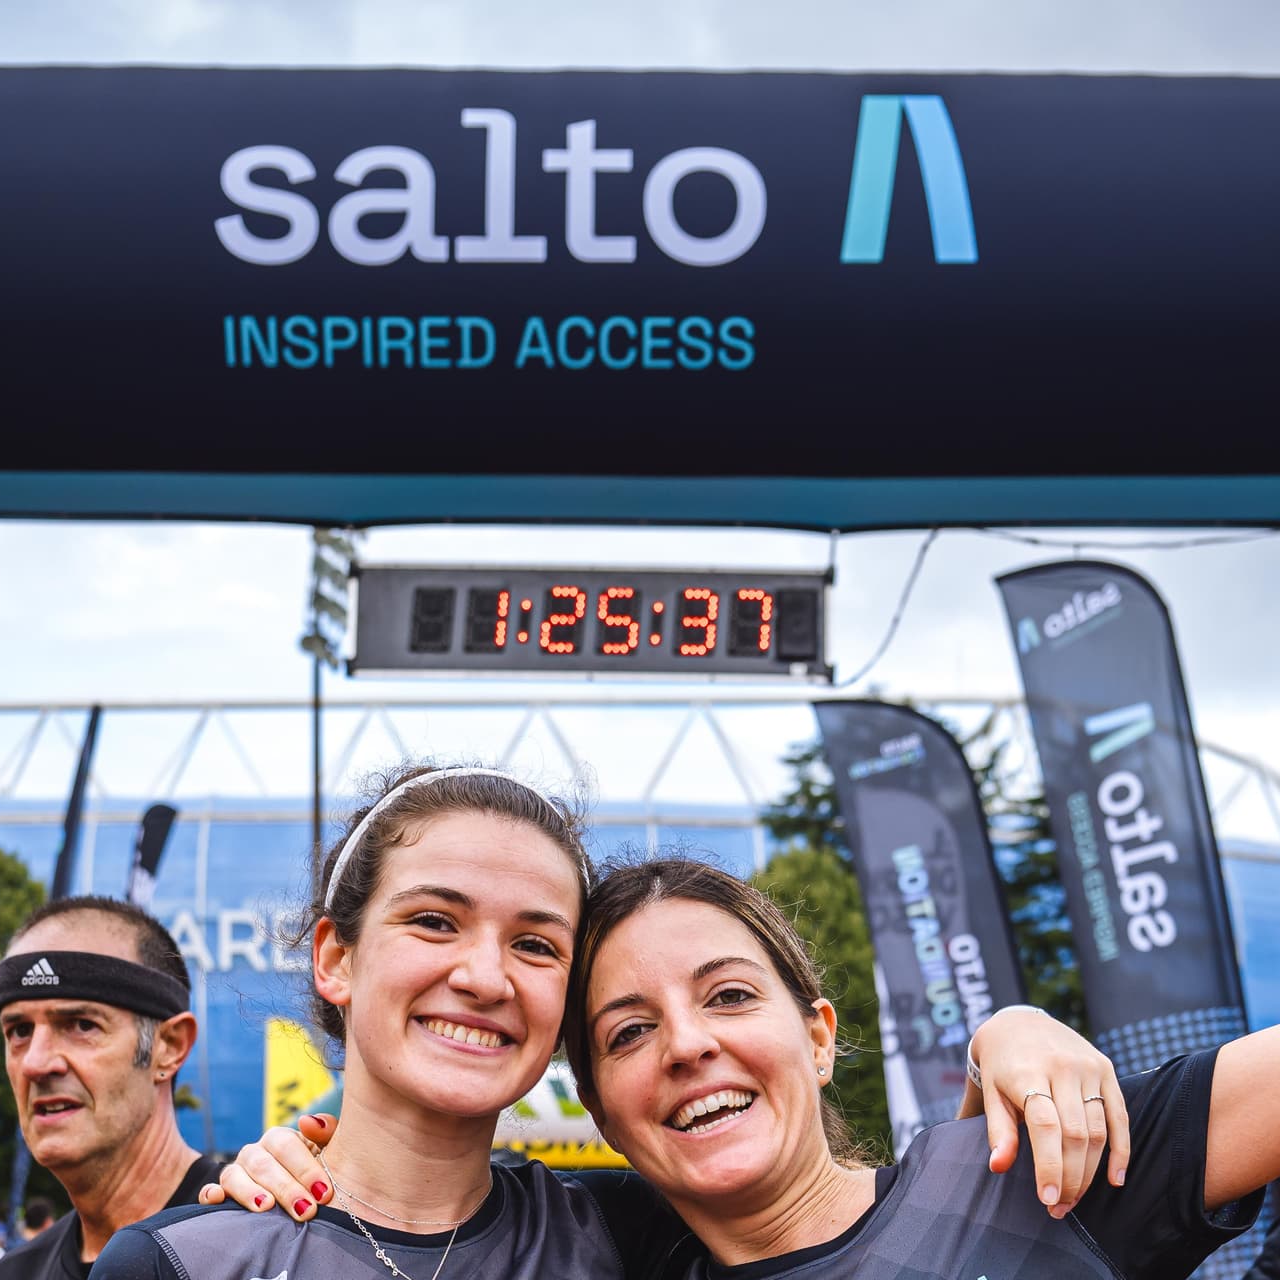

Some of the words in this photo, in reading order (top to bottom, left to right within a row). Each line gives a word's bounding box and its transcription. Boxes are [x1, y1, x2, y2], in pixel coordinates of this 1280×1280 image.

[214, 107, 768, 268] salto
[223, 315, 497, 370] INSPIRED
[515, 316, 756, 370] ACCESS
[490, 586, 774, 654] 1:25:37
[21, 974, 60, 986] adidas
